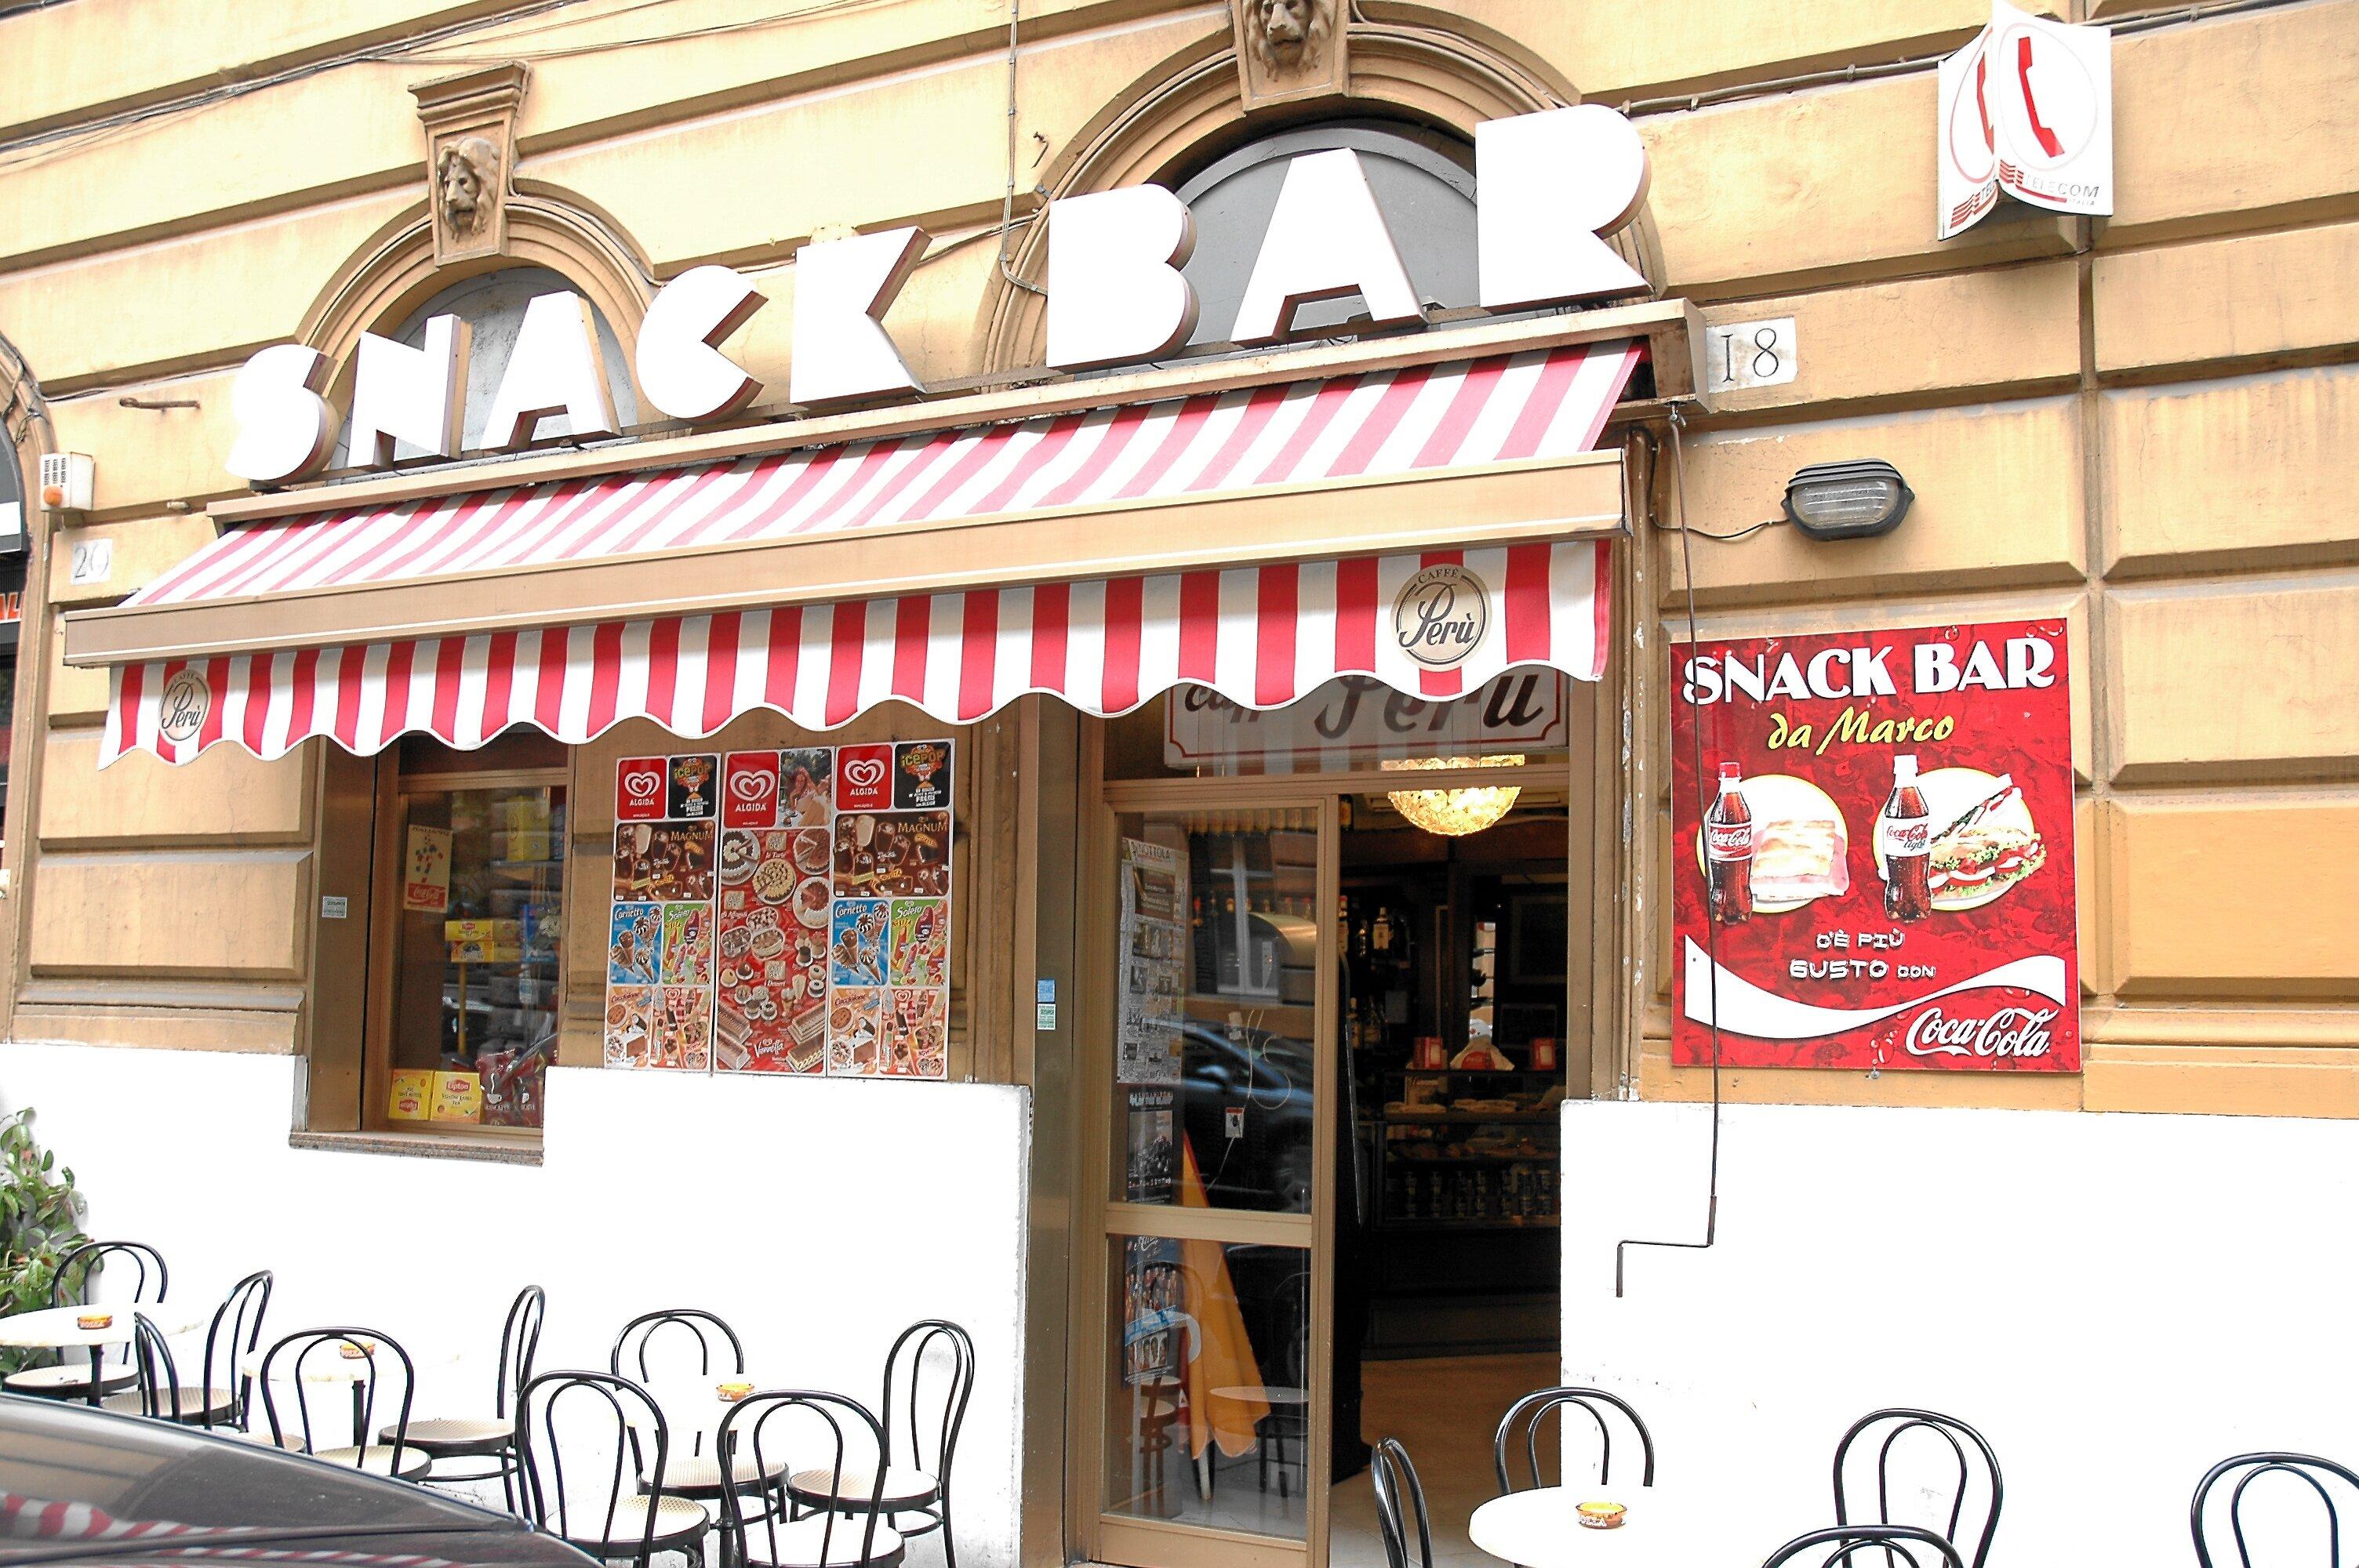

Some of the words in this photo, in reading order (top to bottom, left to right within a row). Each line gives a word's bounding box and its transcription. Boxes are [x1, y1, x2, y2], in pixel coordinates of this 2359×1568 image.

[225, 225, 930, 483] SNACK
[1046, 103, 1652, 372] BAR
[1721, 328, 1779, 383] 18
[74, 543, 110, 580] 20
[1398, 581, 1476, 648] Perù
[1683, 645, 1897, 706] SNACK
[1915, 637, 2055, 693] BAR
[1768, 713, 1811, 750] da
[1816, 706, 1954, 756] Marco
[630, 798, 655, 807] ALGIDA
[849, 787, 878, 797] ALGIDA
[735, 803, 767, 812] ALGIDA
[671, 831, 713, 841] MAGNUM
[898, 822, 947, 833] MAGNUM
[615, 907, 644, 921] Cornetto
[835, 903, 867, 918] Cornetto
[1857, 927, 1906, 949] PIÙ
[1790, 959, 1889, 980] GUSTO
[1904, 1007, 2059, 1058] Coca-Cola
